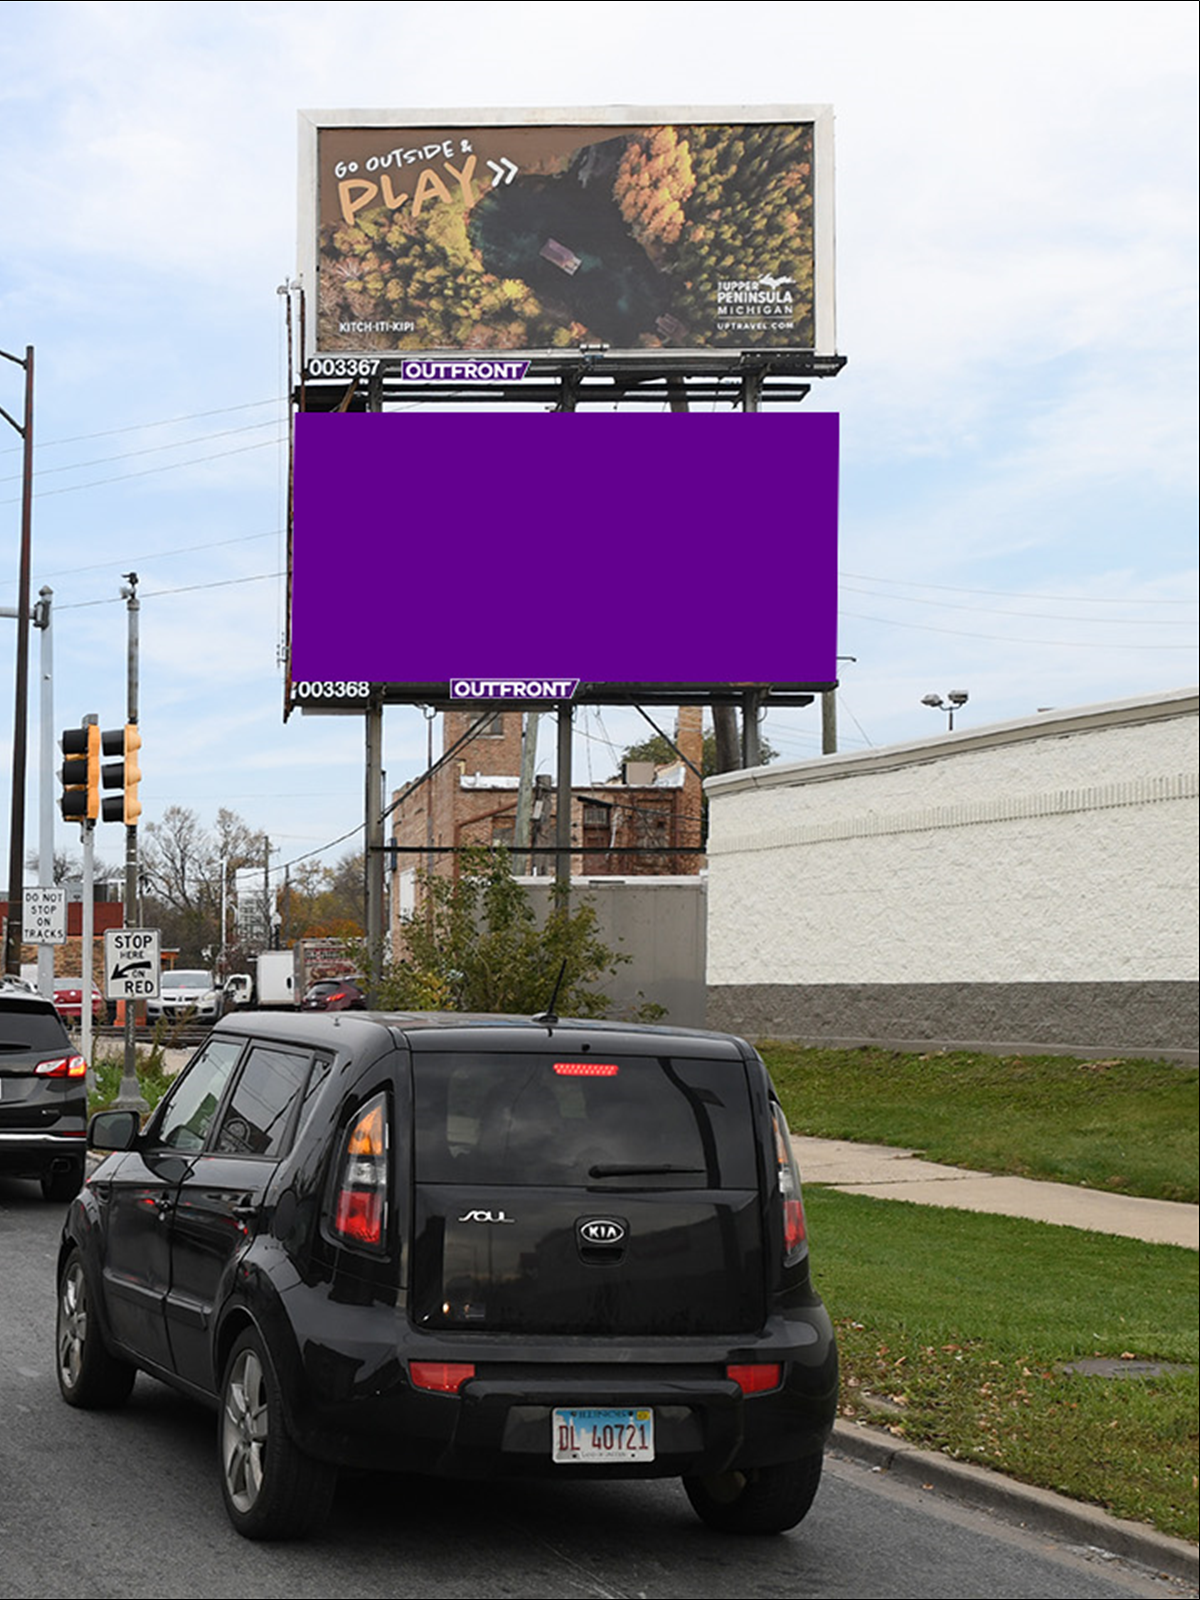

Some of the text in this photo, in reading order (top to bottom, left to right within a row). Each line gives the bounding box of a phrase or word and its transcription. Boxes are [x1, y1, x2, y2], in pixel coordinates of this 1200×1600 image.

[334, 139, 474, 179] GO OUTSIDE &
[338, 154, 477, 226] PLAY
[717, 290, 793, 304] PENINSULA
[717, 305, 793, 315] MICHIGAN
[339, 321, 415, 333] KITCH-ITI-KIPI
[716, 321, 794, 330] UPTRAVEL.COM
[309, 359, 380, 376] 003367
[404, 362, 523, 379] OUTFRONT
[299, 681, 370, 698] 003368
[454, 681, 572, 698] OUTFRONT
[25, 892, 62, 903] DO NOT
[31, 905, 57, 915] STOP
[37, 917, 50, 927] ON
[25, 929, 63, 939] TRACKS
[114, 935, 153, 949] STOP
[120, 950, 145, 960] HERE
[132, 969, 146, 978] ON
[124, 980, 154, 994] RED
[458, 1210, 515, 1223] SOUL
[588, 1225, 617, 1238] KIA
[558, 1424, 649, 1451] DL 40721
